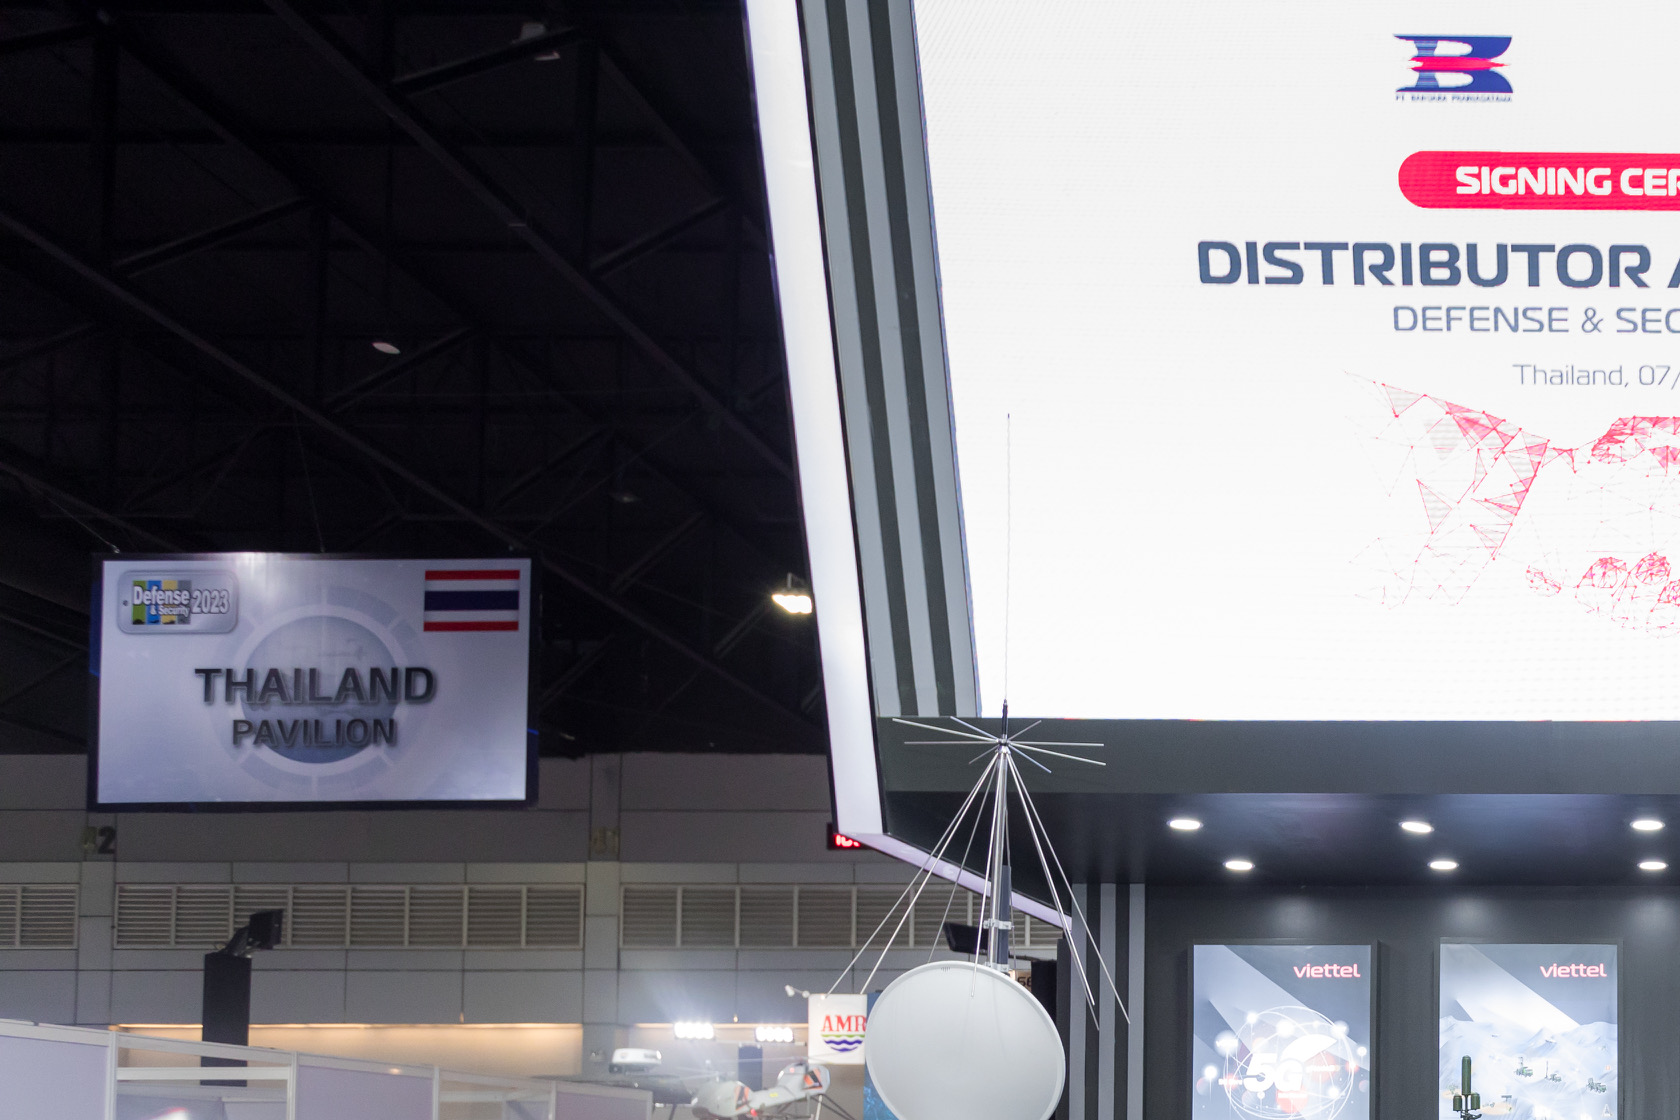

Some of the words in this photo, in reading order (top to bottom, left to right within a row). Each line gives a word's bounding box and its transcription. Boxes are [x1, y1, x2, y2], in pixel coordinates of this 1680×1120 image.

[1455, 166, 1612, 197] SIGNING
[1198, 240, 1651, 289] DISTRIBUTOR
[1393, 305, 1569, 333] DEFENSE
[1581, 307, 1604, 334] &
[1512, 363, 1629, 389] Thailand,
[132, 585, 191, 605] Defense
[191, 589, 231, 614] 2023
[158, 605, 191, 617] Security
[194, 666, 438, 706] THAILAND
[231, 717, 398, 749] PAVILION
[1293, 963, 1361, 979] viettel
[1540, 963, 1607, 978] viettel
